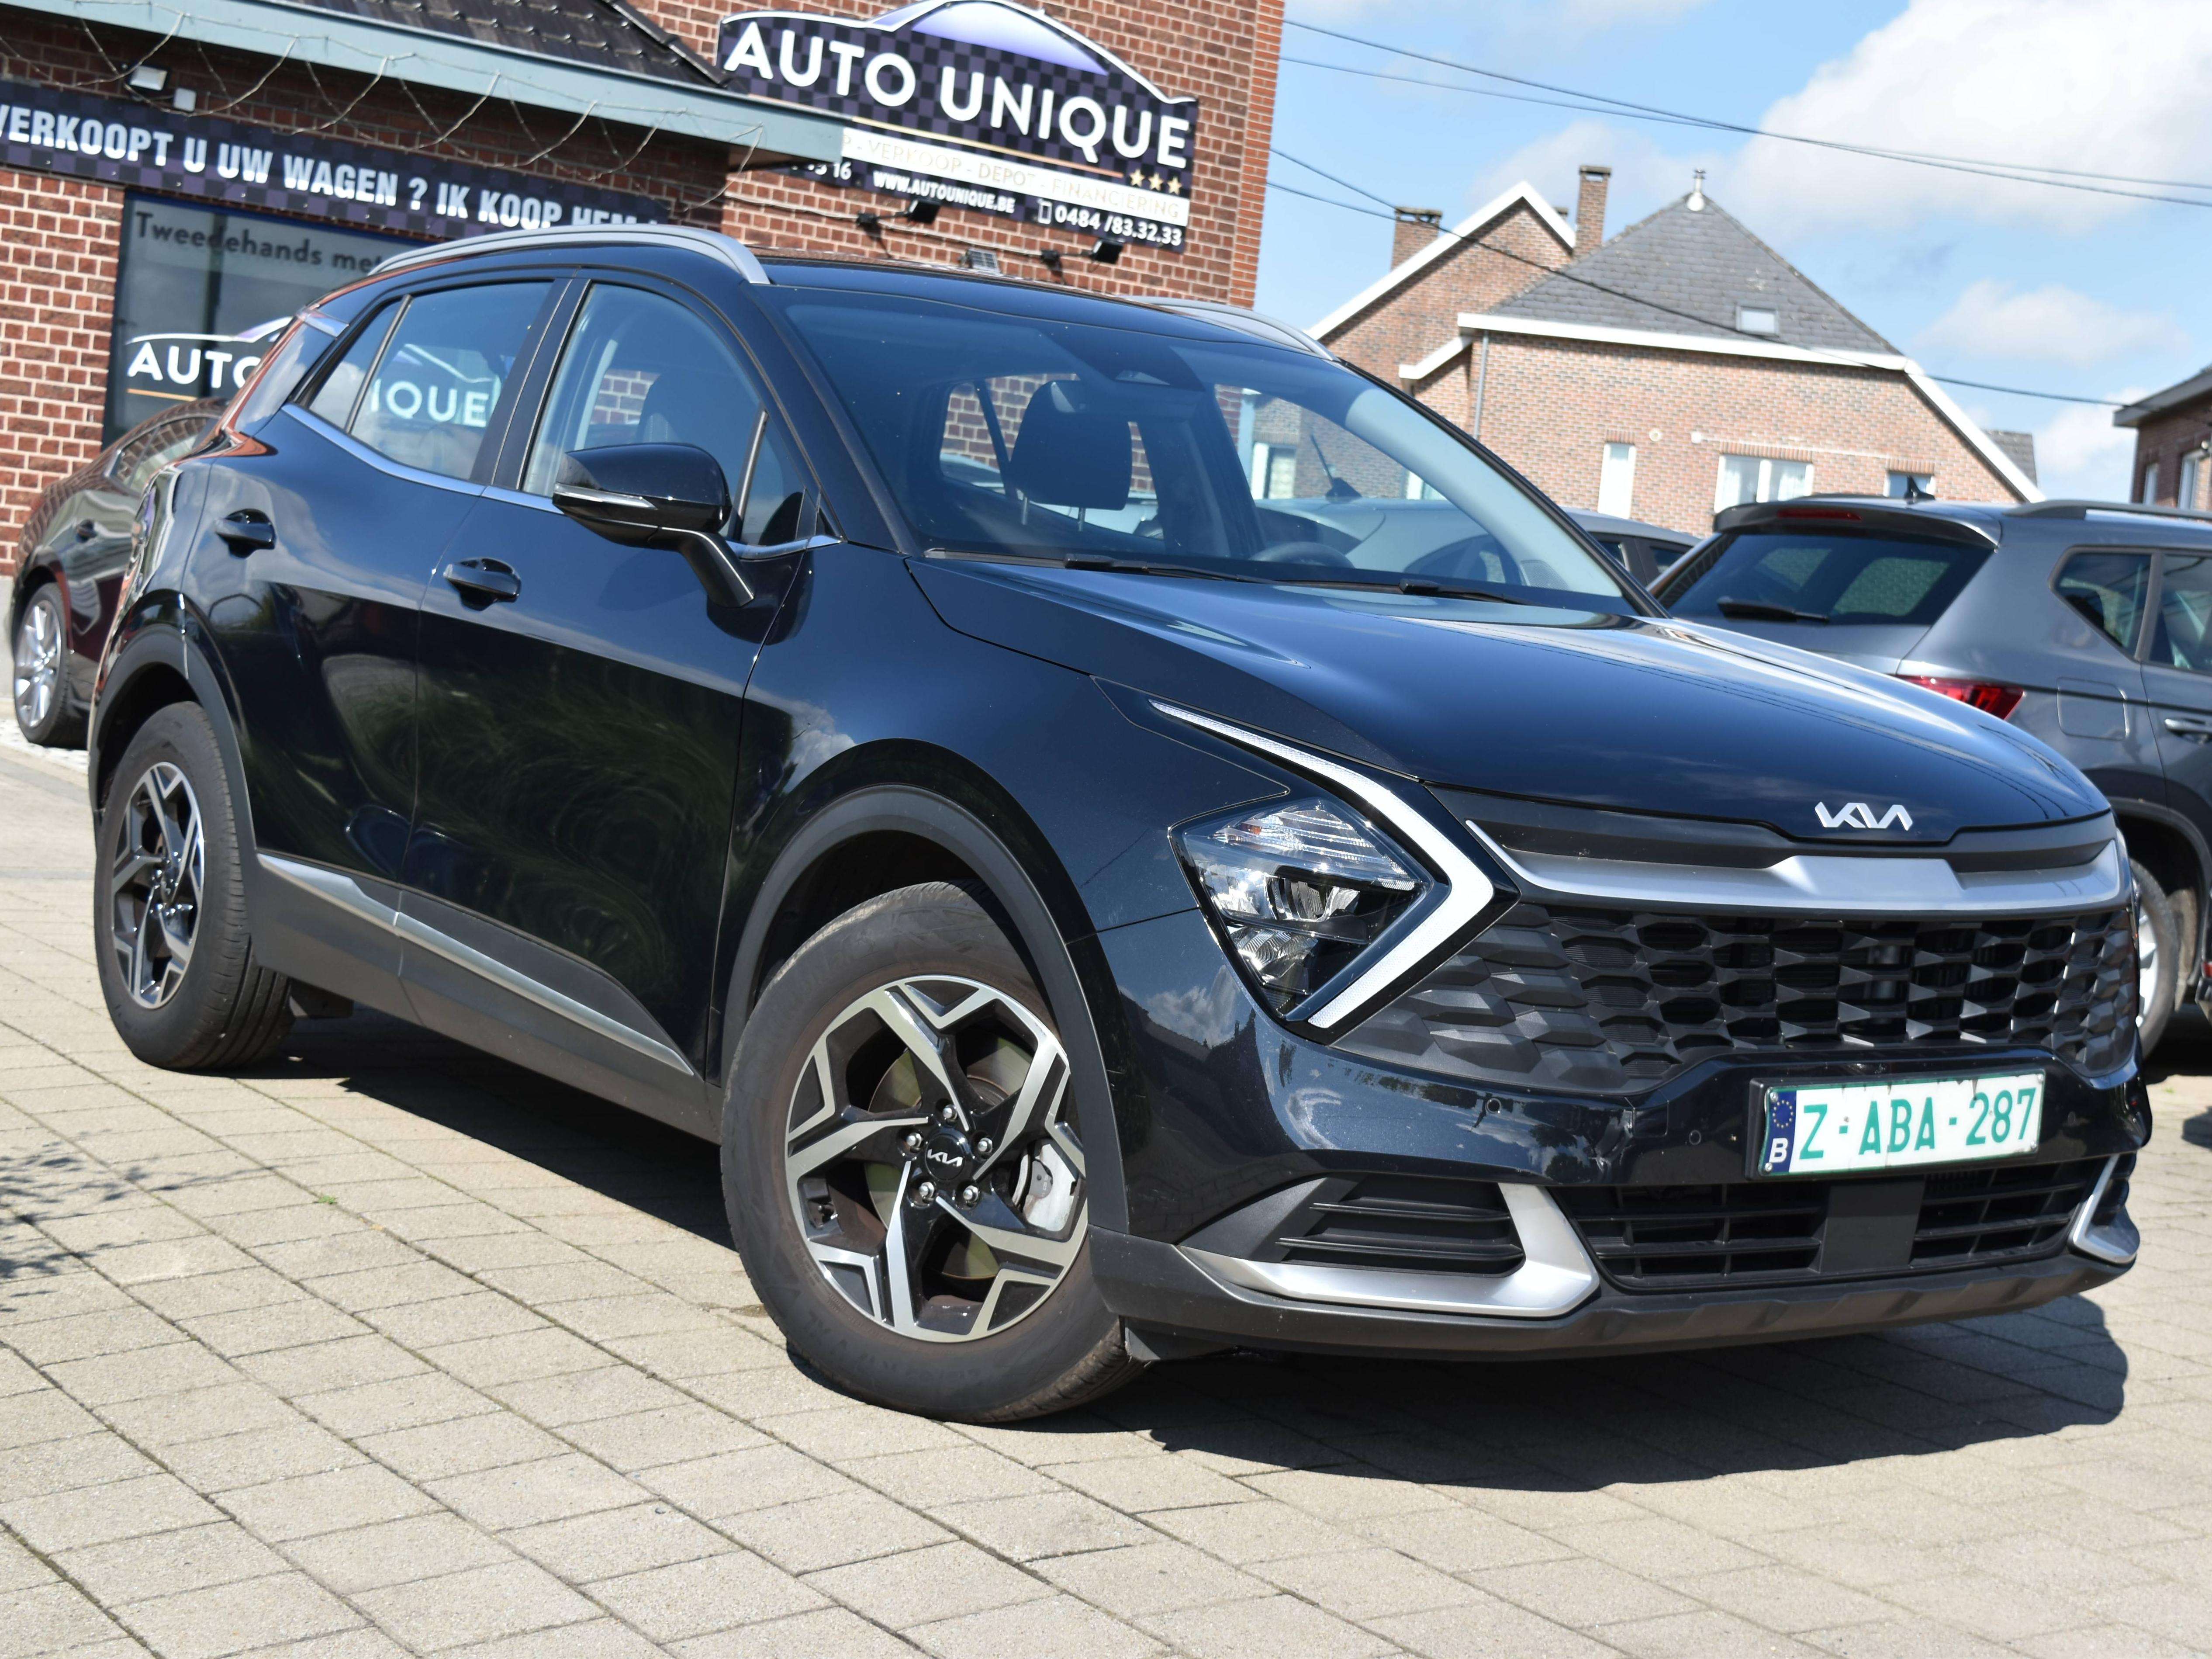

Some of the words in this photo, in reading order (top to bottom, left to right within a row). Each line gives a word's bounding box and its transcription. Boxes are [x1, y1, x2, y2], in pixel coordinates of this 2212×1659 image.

[723, 21, 916, 107] AUTO
[939, 66, 1190, 169] UNIQUE
[184, 137, 207, 173] U
[217, 142, 273, 184] UW
[283, 153, 398, 207] WAGEN
[436, 182, 470, 218] IK
[477, 188, 563, 229] KOOP
[868, 139, 963, 173] VERKOOP
[978, 163, 1034, 186] DEPOT
[1051, 178, 1179, 219] FINANCIERING
[873, 171, 1016, 214] WWW.AUTOUNIQUE.BE
[135, 211, 322, 265] Tweedehands
[1054, 204, 1101, 230] 0484
[1815, 801, 1913, 831] KIA
[1799, 1088, 2036, 1160] Z-ABA-287
[927, 1149, 963, 1167] KIA
[1770, 1137, 1789, 1164] B
